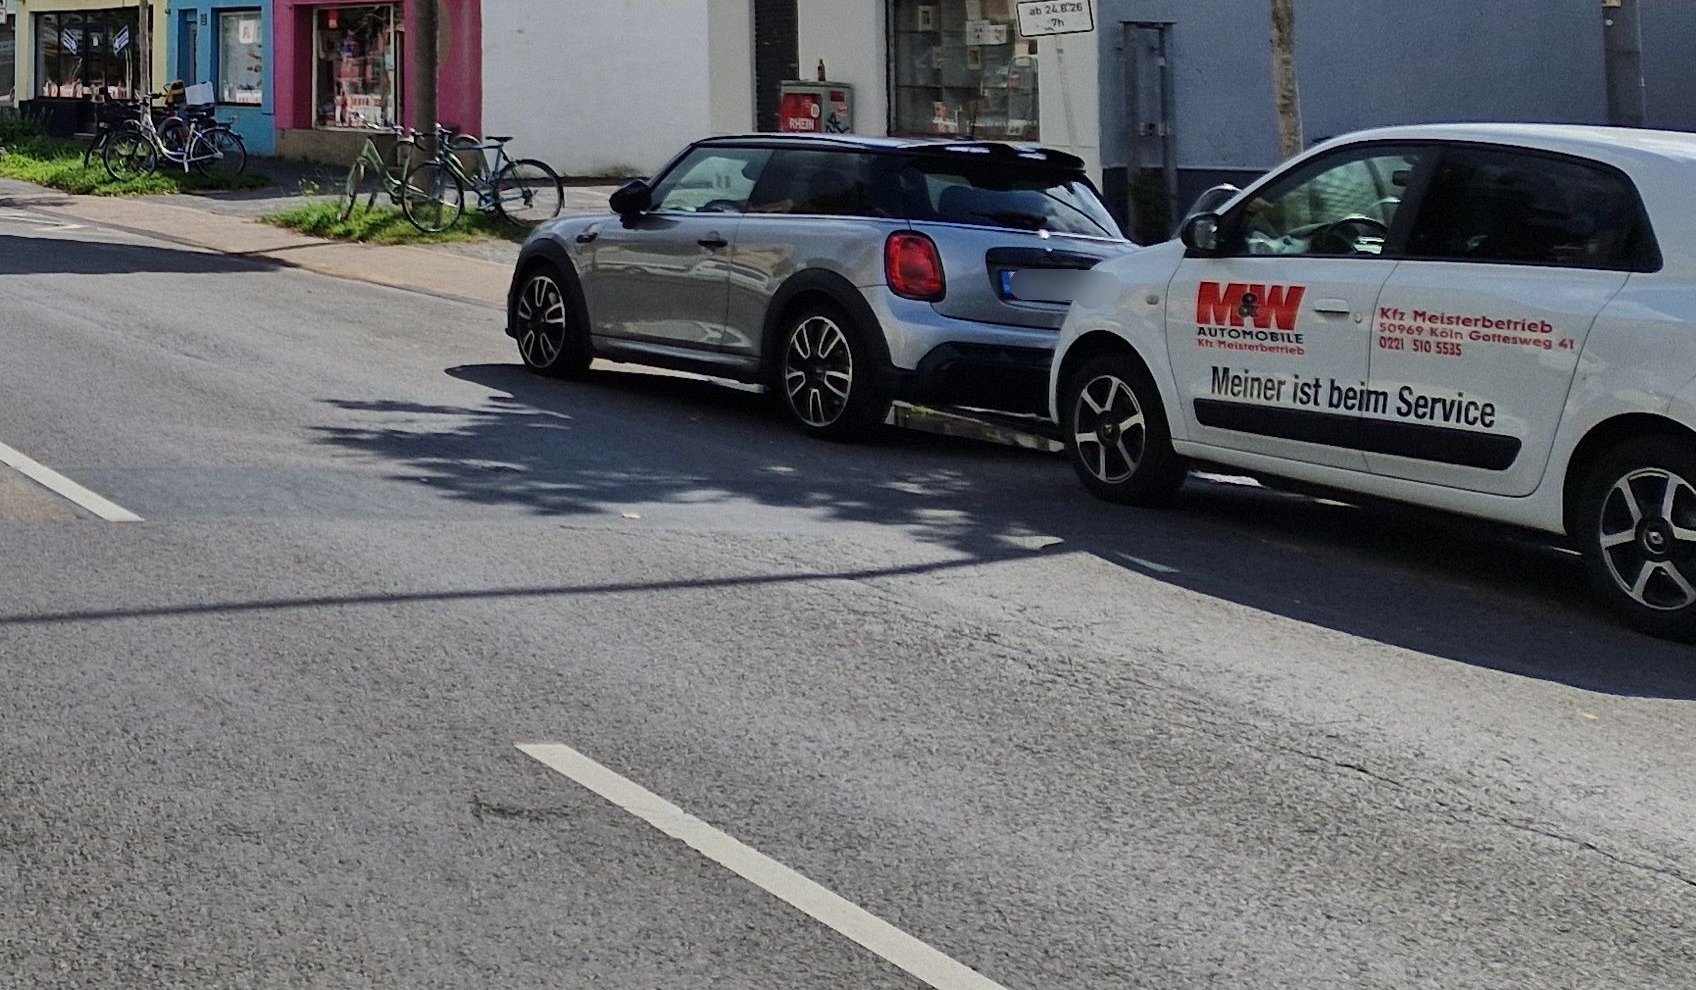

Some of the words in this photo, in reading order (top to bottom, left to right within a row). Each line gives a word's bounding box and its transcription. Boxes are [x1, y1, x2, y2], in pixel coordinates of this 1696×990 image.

[1029, 6, 1042, 16] ab
[1380, 307, 1406, 322] Kfz
[1413, 310, 1553, 334] Meisterbetrieb
[1197, 326, 1304, 345] AUTOMOBILE
[1379, 322, 1424, 335] 50969
[1429, 327, 1464, 340] Köln
[1469, 330, 1552, 351] Gottesweg
[1558, 338, 1575, 350] 41
[1197, 338, 1214, 348] Kfz
[1218, 339, 1305, 356] Meisterbetrieb
[1379, 336, 1404, 351] 0221
[1412, 338, 1432, 354] 510
[1435, 341, 1463, 357] 5535
[1211, 364, 1287, 403] Meiner
[1292, 373, 1322, 407] ist
[1328, 377, 1389, 415] beim
[1396, 384, 1496, 429] Service
